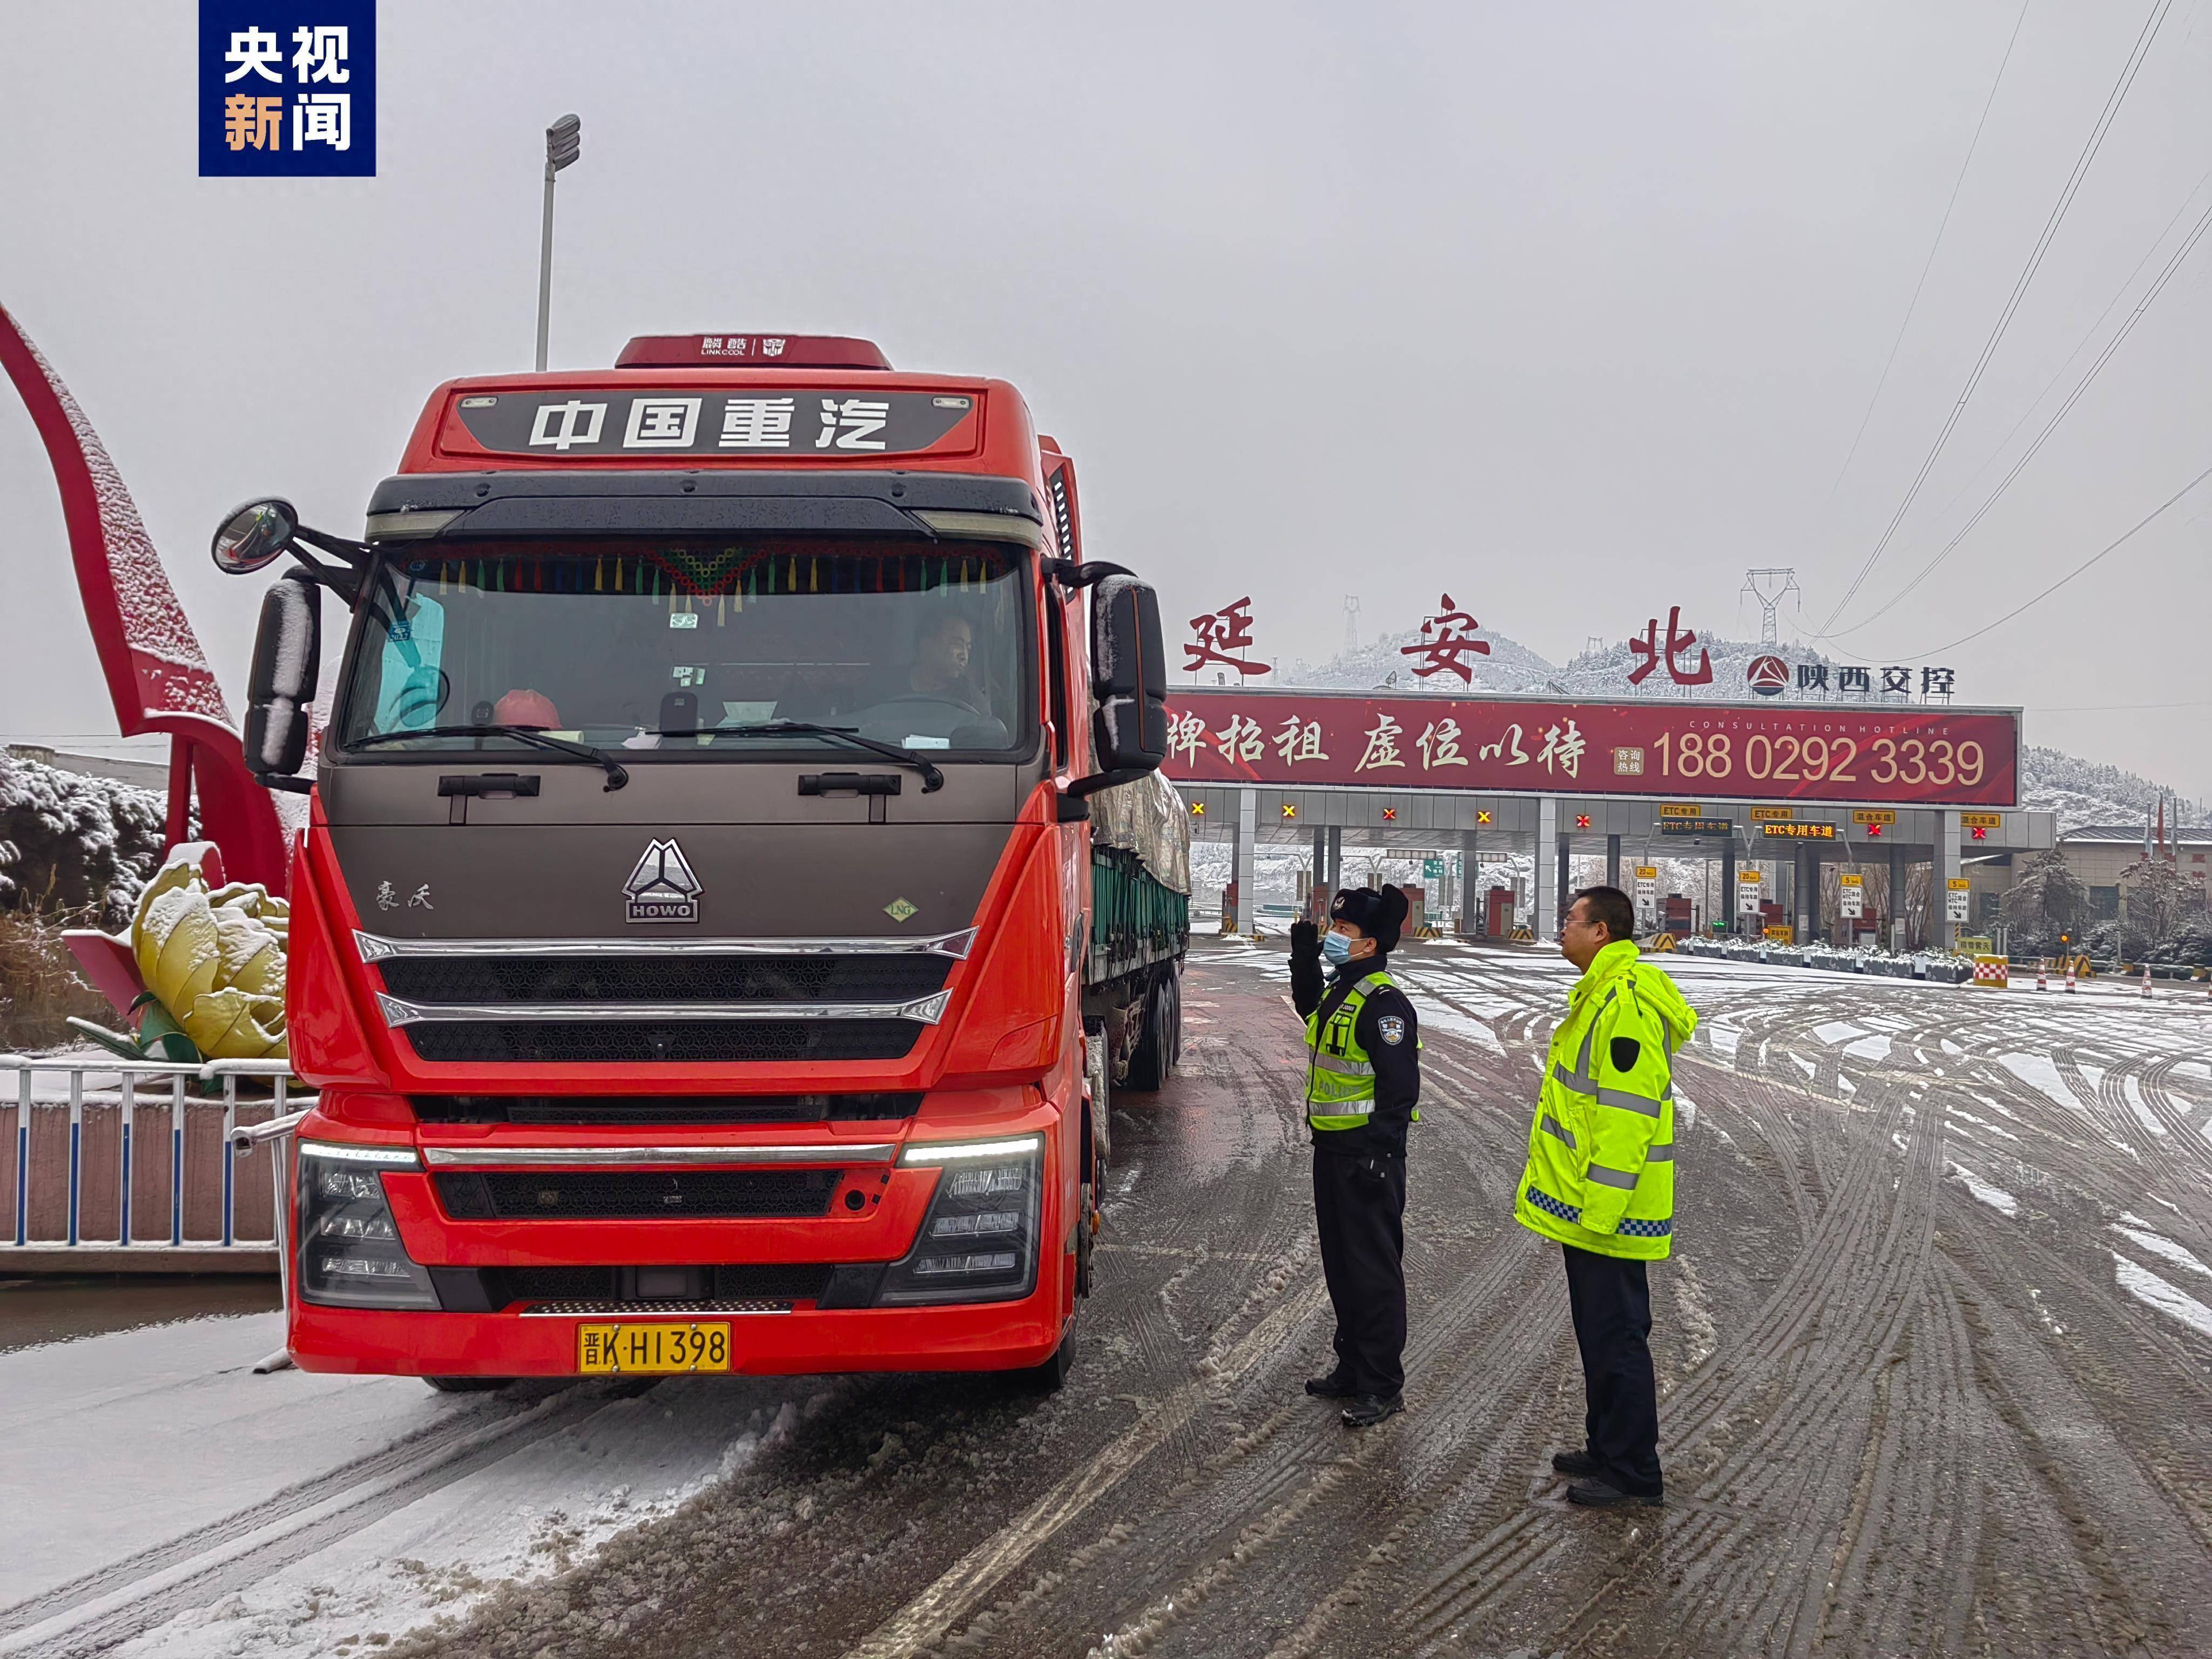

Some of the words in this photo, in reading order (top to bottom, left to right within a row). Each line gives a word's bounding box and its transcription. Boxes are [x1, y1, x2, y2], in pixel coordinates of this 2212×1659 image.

[529, 398, 889, 450] 中国重汽
[1183, 593, 1713, 685] 延安北
[1798, 664, 1955, 693] 陕西交控
[1690, 721, 1845, 732] CONSULTATION
[1860, 726, 1949, 735] HOTLINE
[1354, 713, 1586, 778] 虚位以待
[1618, 750, 1640, 760] 咨询
[1654, 732, 1732, 778] 188
[1745, 735, 1857, 781] 0292
[1871, 738, 1984, 786] 3339
[1617, 762, 1640, 772] 热线
[1765, 824, 1833, 837] ETC专用车道
[632, 906, 691, 916] HOWO
[891, 904, 911, 915] LNG
